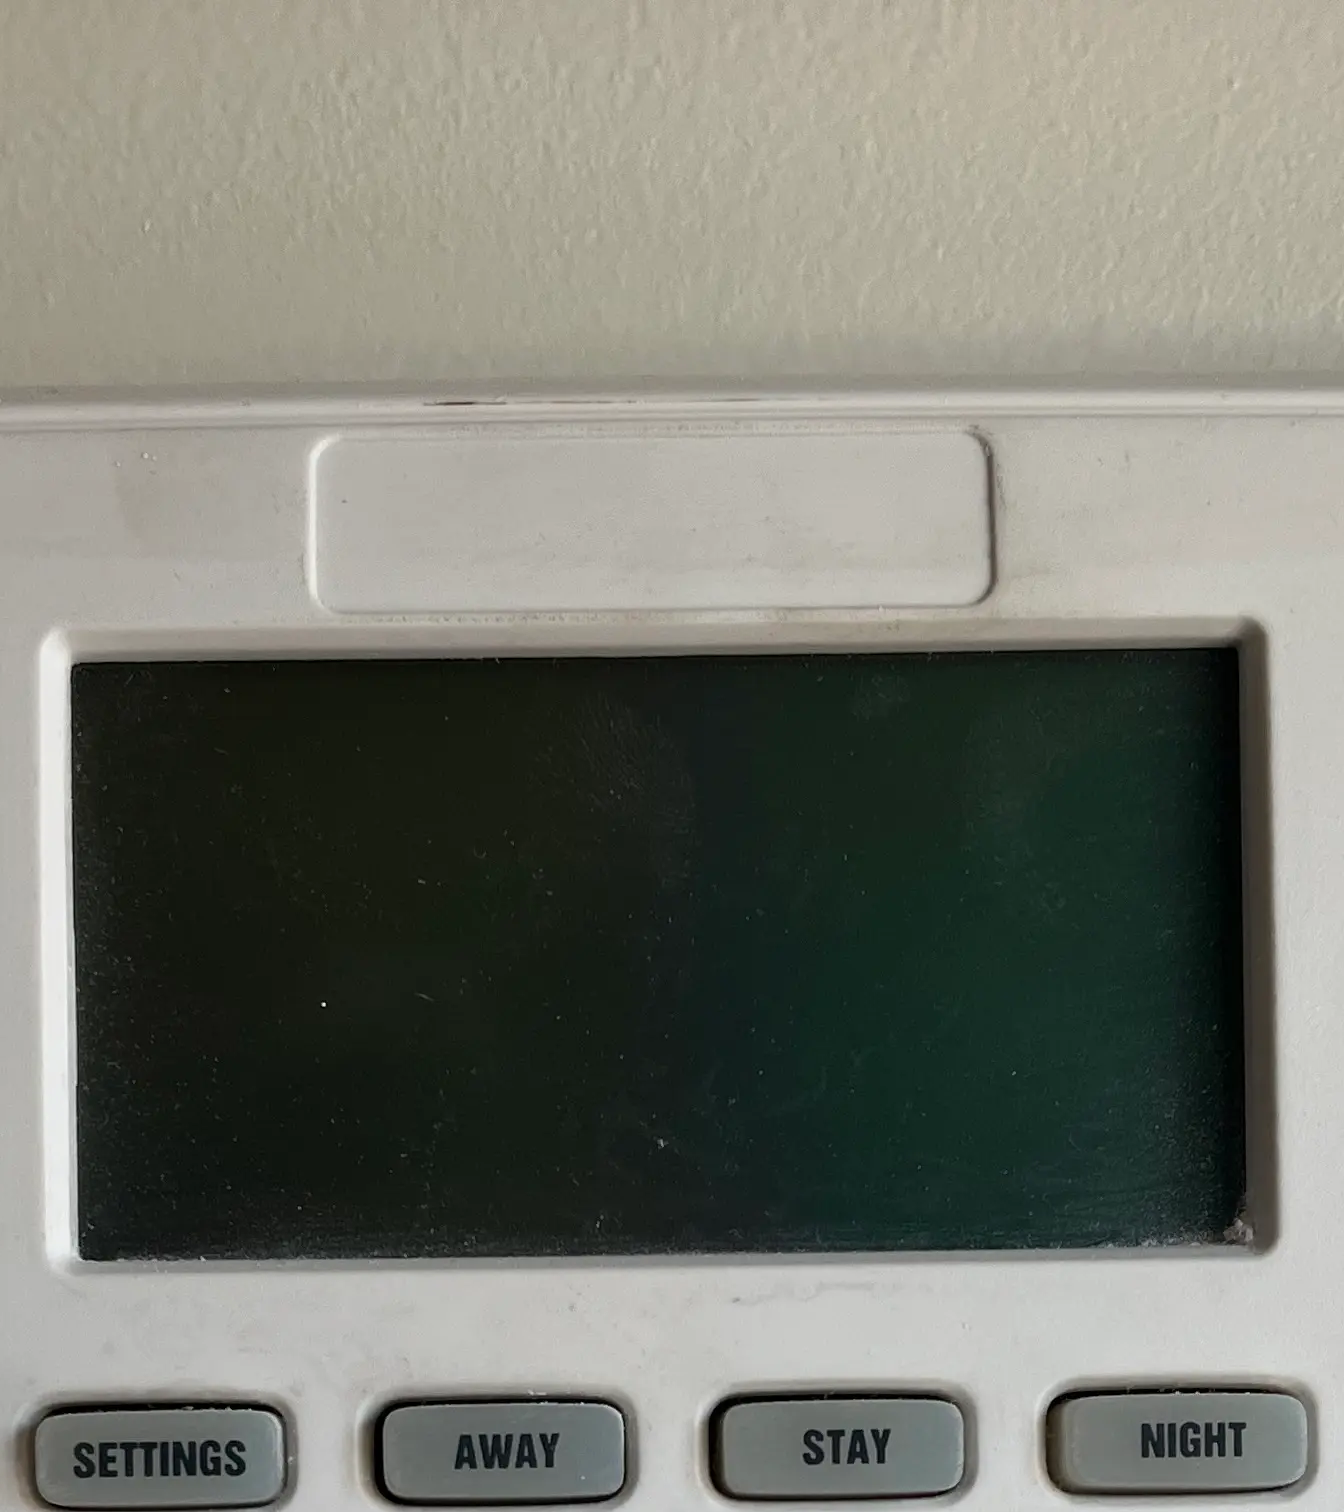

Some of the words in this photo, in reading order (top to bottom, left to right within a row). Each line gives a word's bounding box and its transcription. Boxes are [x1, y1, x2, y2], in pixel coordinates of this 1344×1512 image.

[73, 1439, 246, 1479] SETTINGS
[454, 1432, 560, 1470] AWAY
[802, 1428, 891, 1466] STAY
[1140, 1421, 1247, 1459] NIGHT
